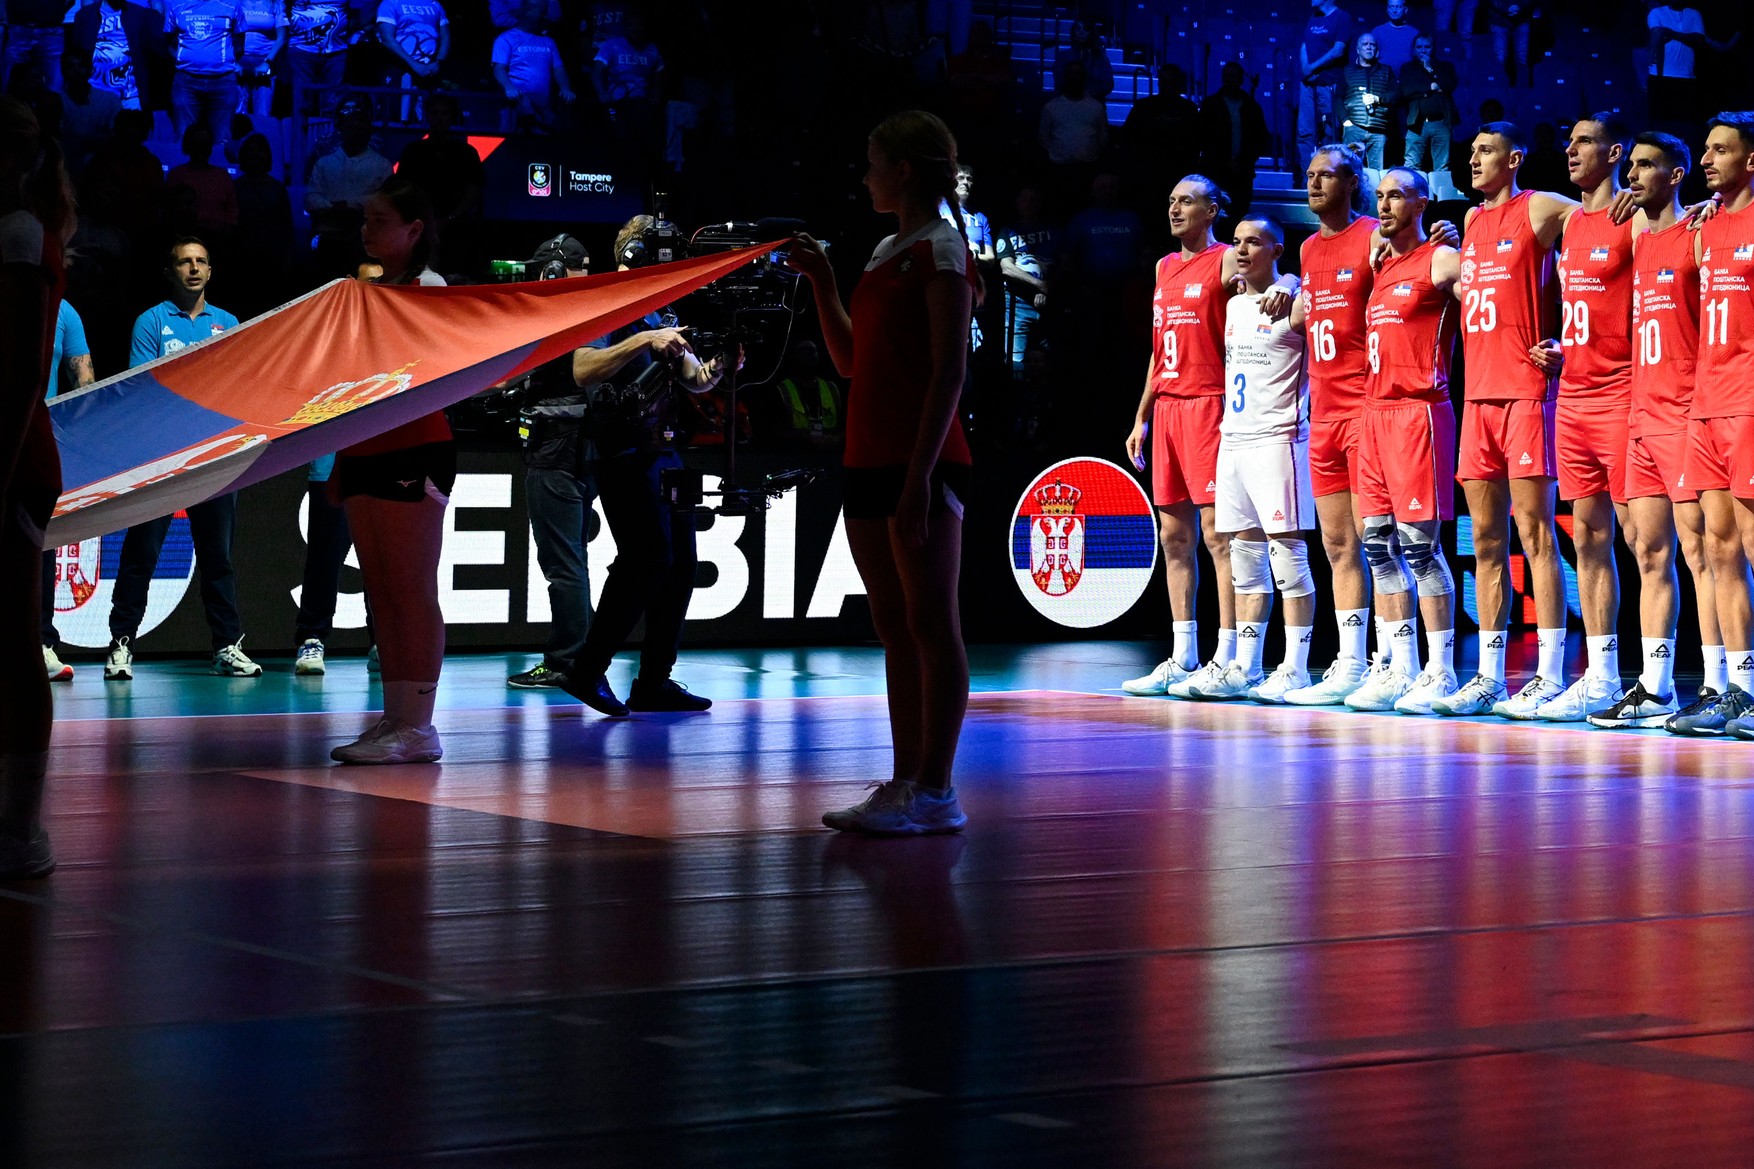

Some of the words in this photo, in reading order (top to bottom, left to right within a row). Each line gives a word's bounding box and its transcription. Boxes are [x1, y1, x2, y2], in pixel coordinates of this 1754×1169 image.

[401, 4, 435, 16] EESTI
[569, 170, 612, 183] Tampere
[569, 182, 592, 192] Host
[594, 182, 615, 195] City
[1091, 226, 1131, 234] ESTONIA
[1465, 287, 1497, 333] 25
[1562, 300, 1590, 347] 29
[1706, 297, 1729, 346] 11
[1163, 330, 1178, 371] 9
[1309, 319, 1337, 363] 16
[1368, 331, 1380, 375] 8
[1638, 319, 1662, 367] 10
[1232, 373, 1246, 414] 3
